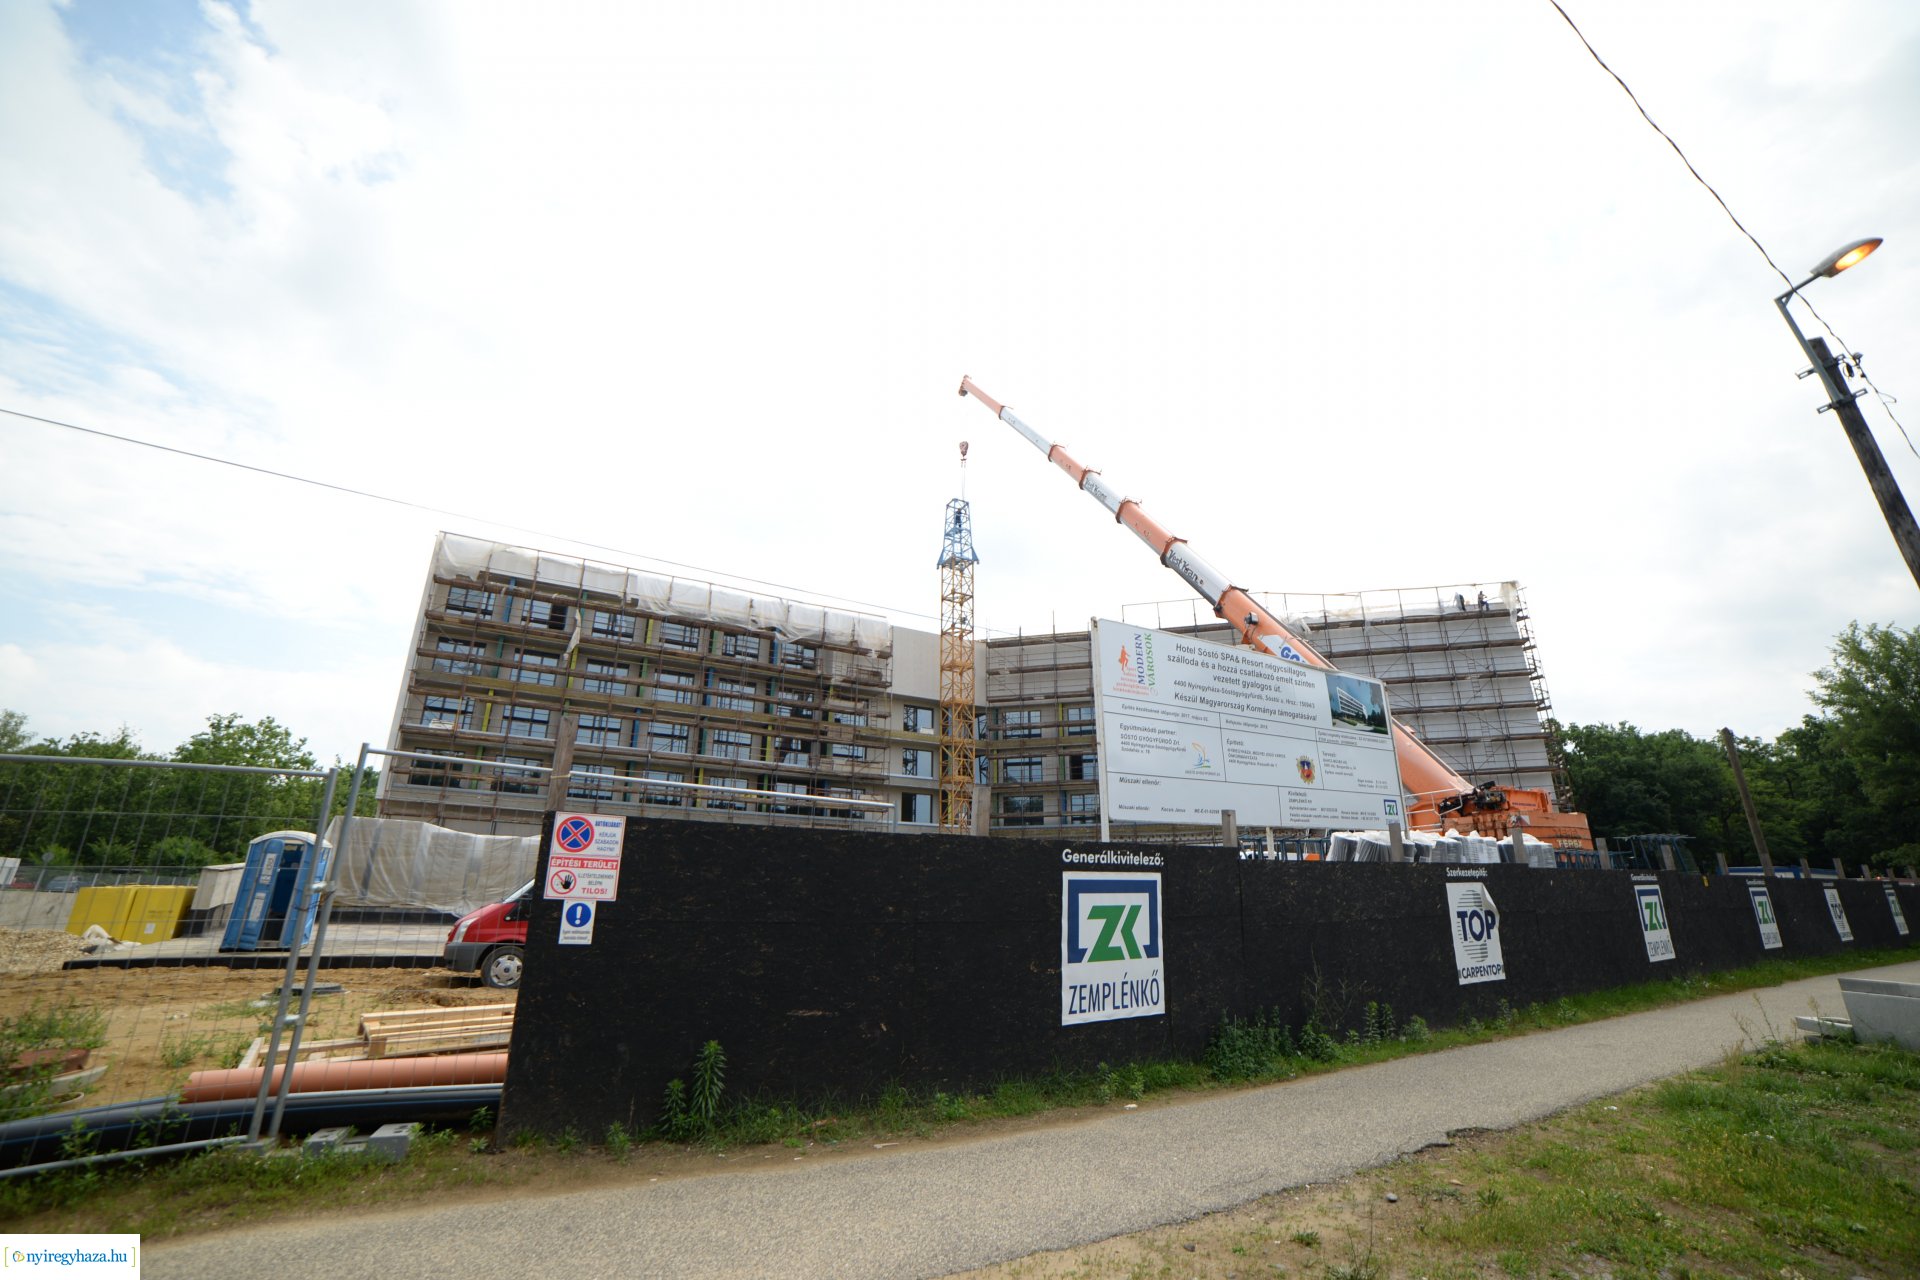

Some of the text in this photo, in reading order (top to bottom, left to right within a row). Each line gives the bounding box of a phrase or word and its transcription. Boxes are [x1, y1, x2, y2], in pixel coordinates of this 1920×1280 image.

[1134, 633, 1145, 685] MODERN
[1168, 655, 1198, 666] szálloda
[1201, 660, 1209, 668] és
[1217, 663, 1238, 674] hozzá
[1240, 669, 1275, 681] csatlakozó
[1276, 675, 1293, 684] emelt
[1176, 643, 1306, 677] Hotel Sóstó SPA& Resort négycsillagos
[1213, 675, 1240, 686] vezetett
[1242, 680, 1272, 691] gyalogos
[1174, 692, 1317, 721] Készül Magyarország Kormánya támogatásával
[552, 856, 618, 869] ÉPÍTÉSI TERÜLET
[582, 887, 608, 895] TILOS!
[1456, 909, 1497, 942] TOP
[1461, 963, 1502, 979] CARPENTOP
[1068, 969, 1160, 1015] ZEMPLÉNKŐ
